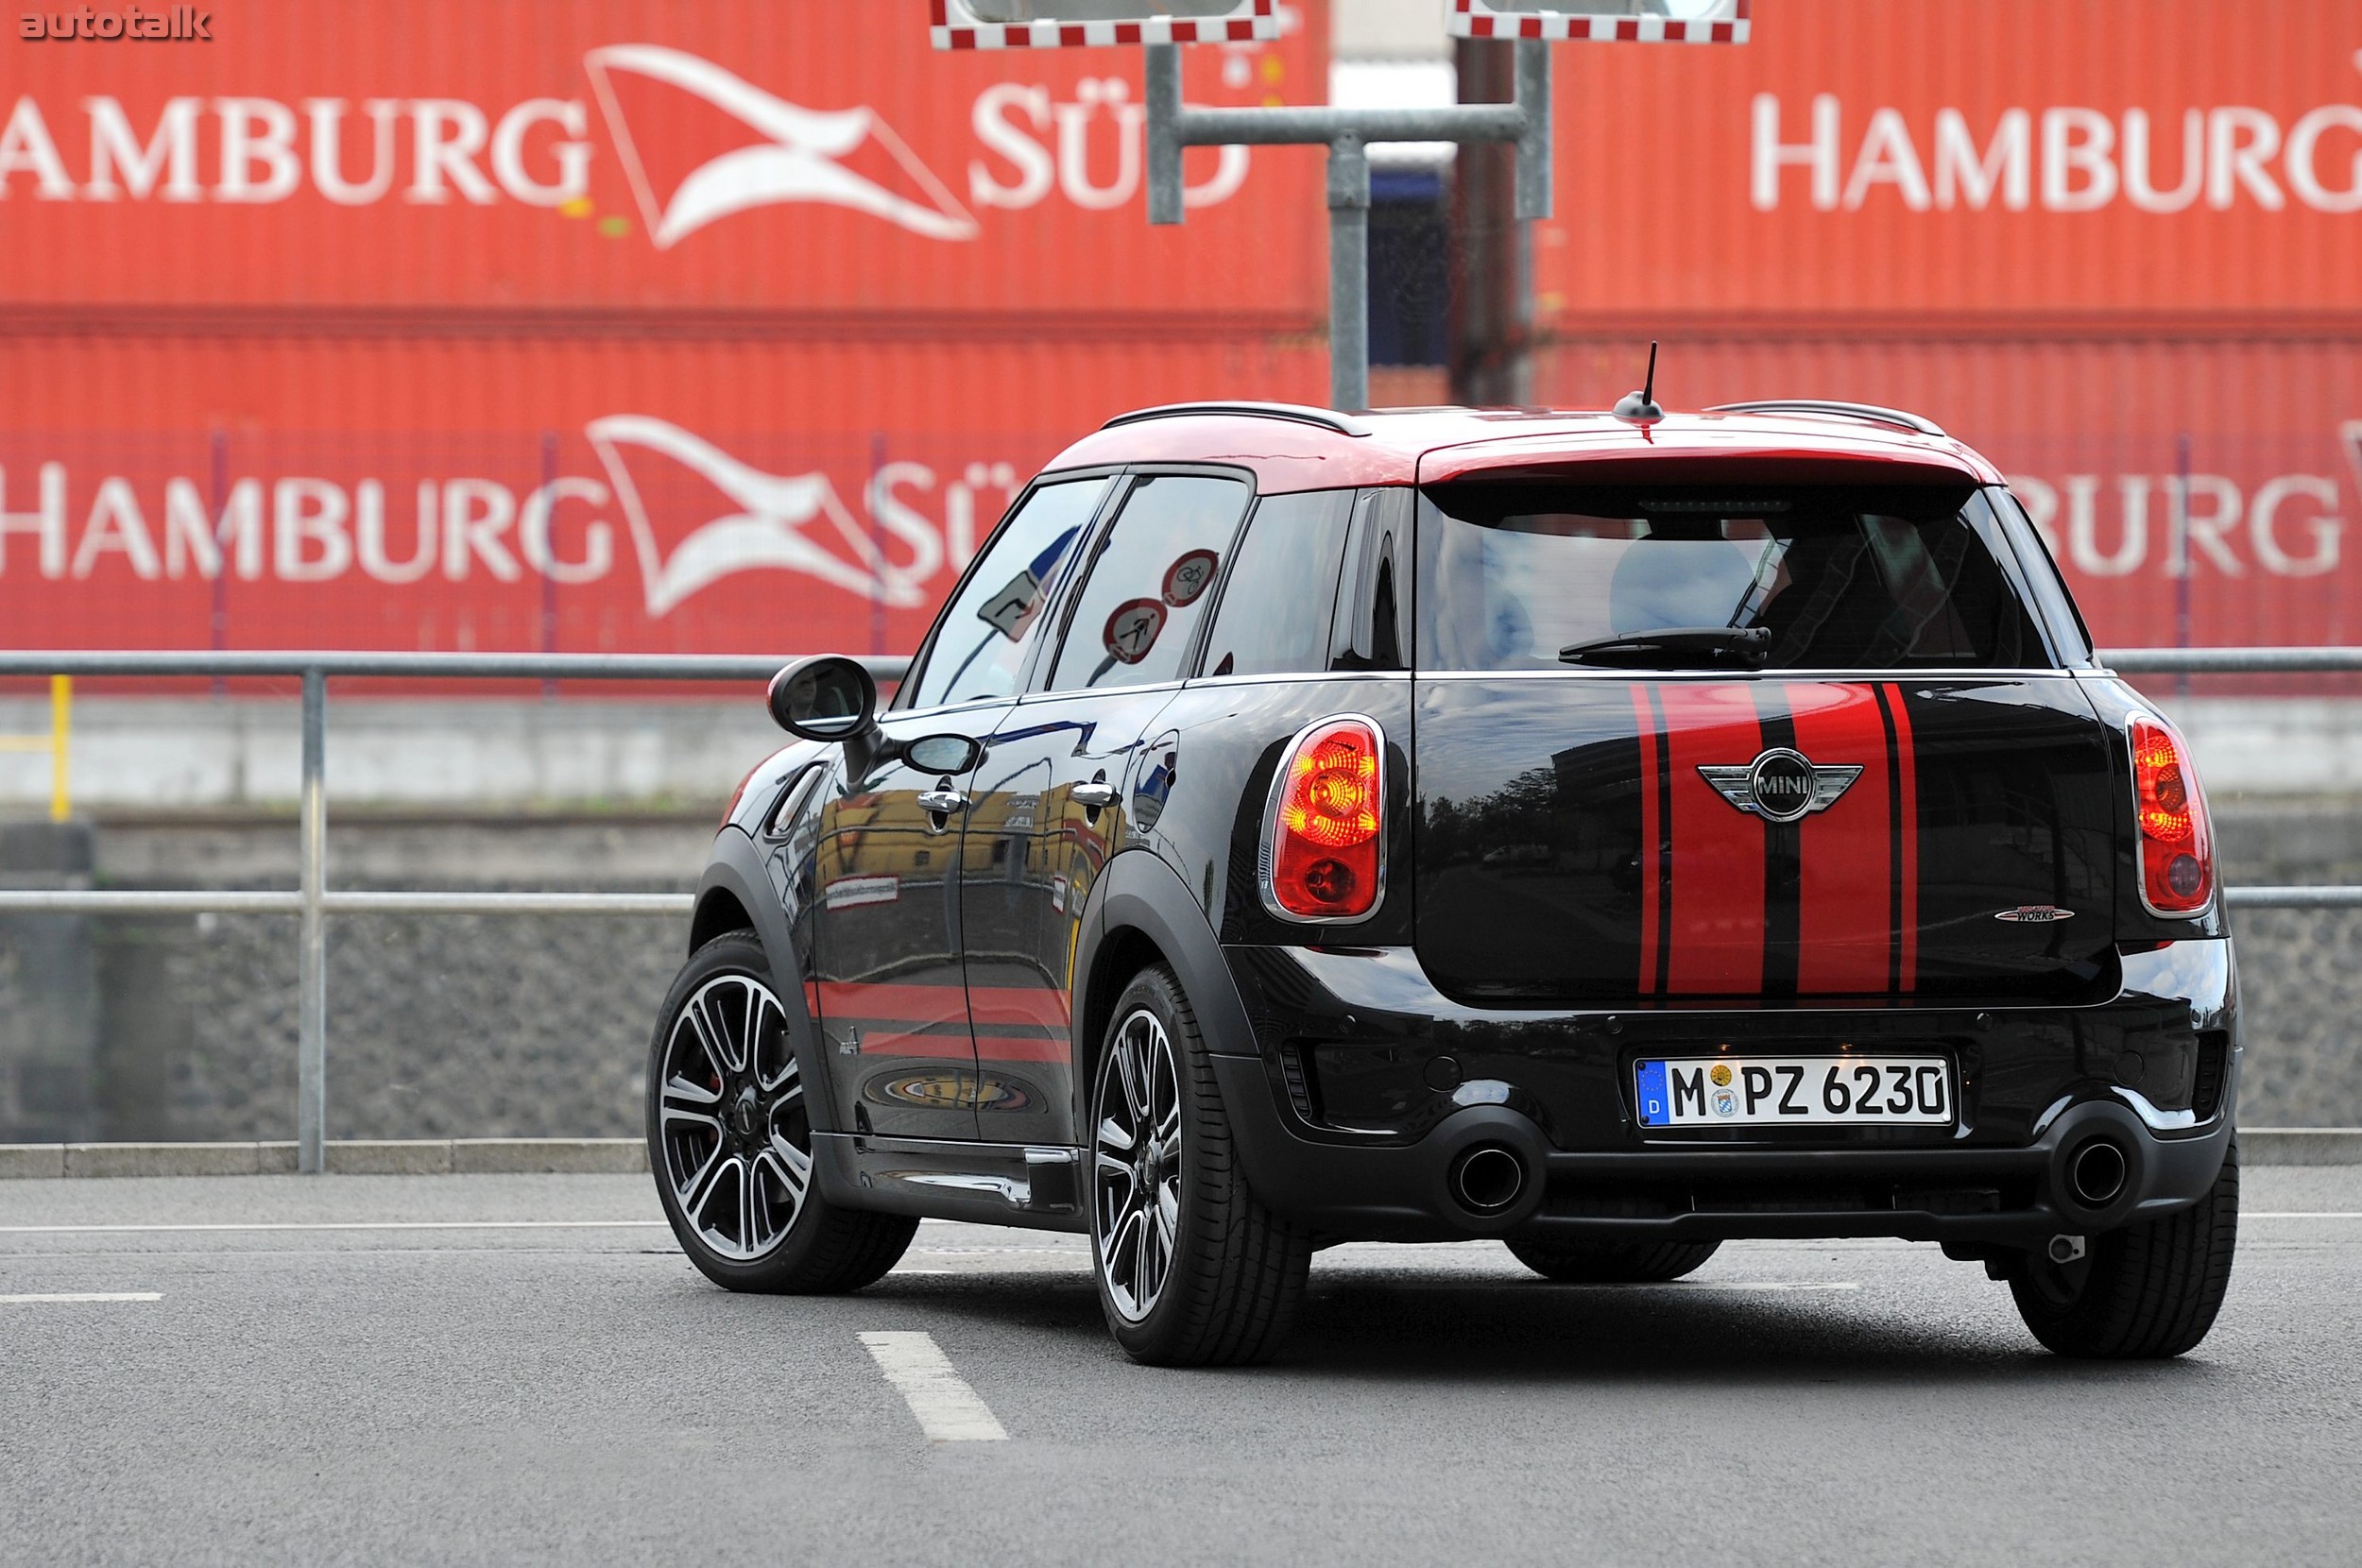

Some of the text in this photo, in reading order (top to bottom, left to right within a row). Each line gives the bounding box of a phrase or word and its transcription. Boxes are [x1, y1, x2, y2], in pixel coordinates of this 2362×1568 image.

[1750, 93, 2362, 213] HAMBURG
[0, 460, 613, 583] HAMBURG
[1757, 775, 1808, 794] MINI
[2017, 912, 2055, 921] WORKS
[1649, 1099, 1660, 1114] D
[1671, 1067, 1706, 1116] M
[1740, 1065, 1808, 1115] PZ
[1823, 1065, 1944, 1115] 6230
